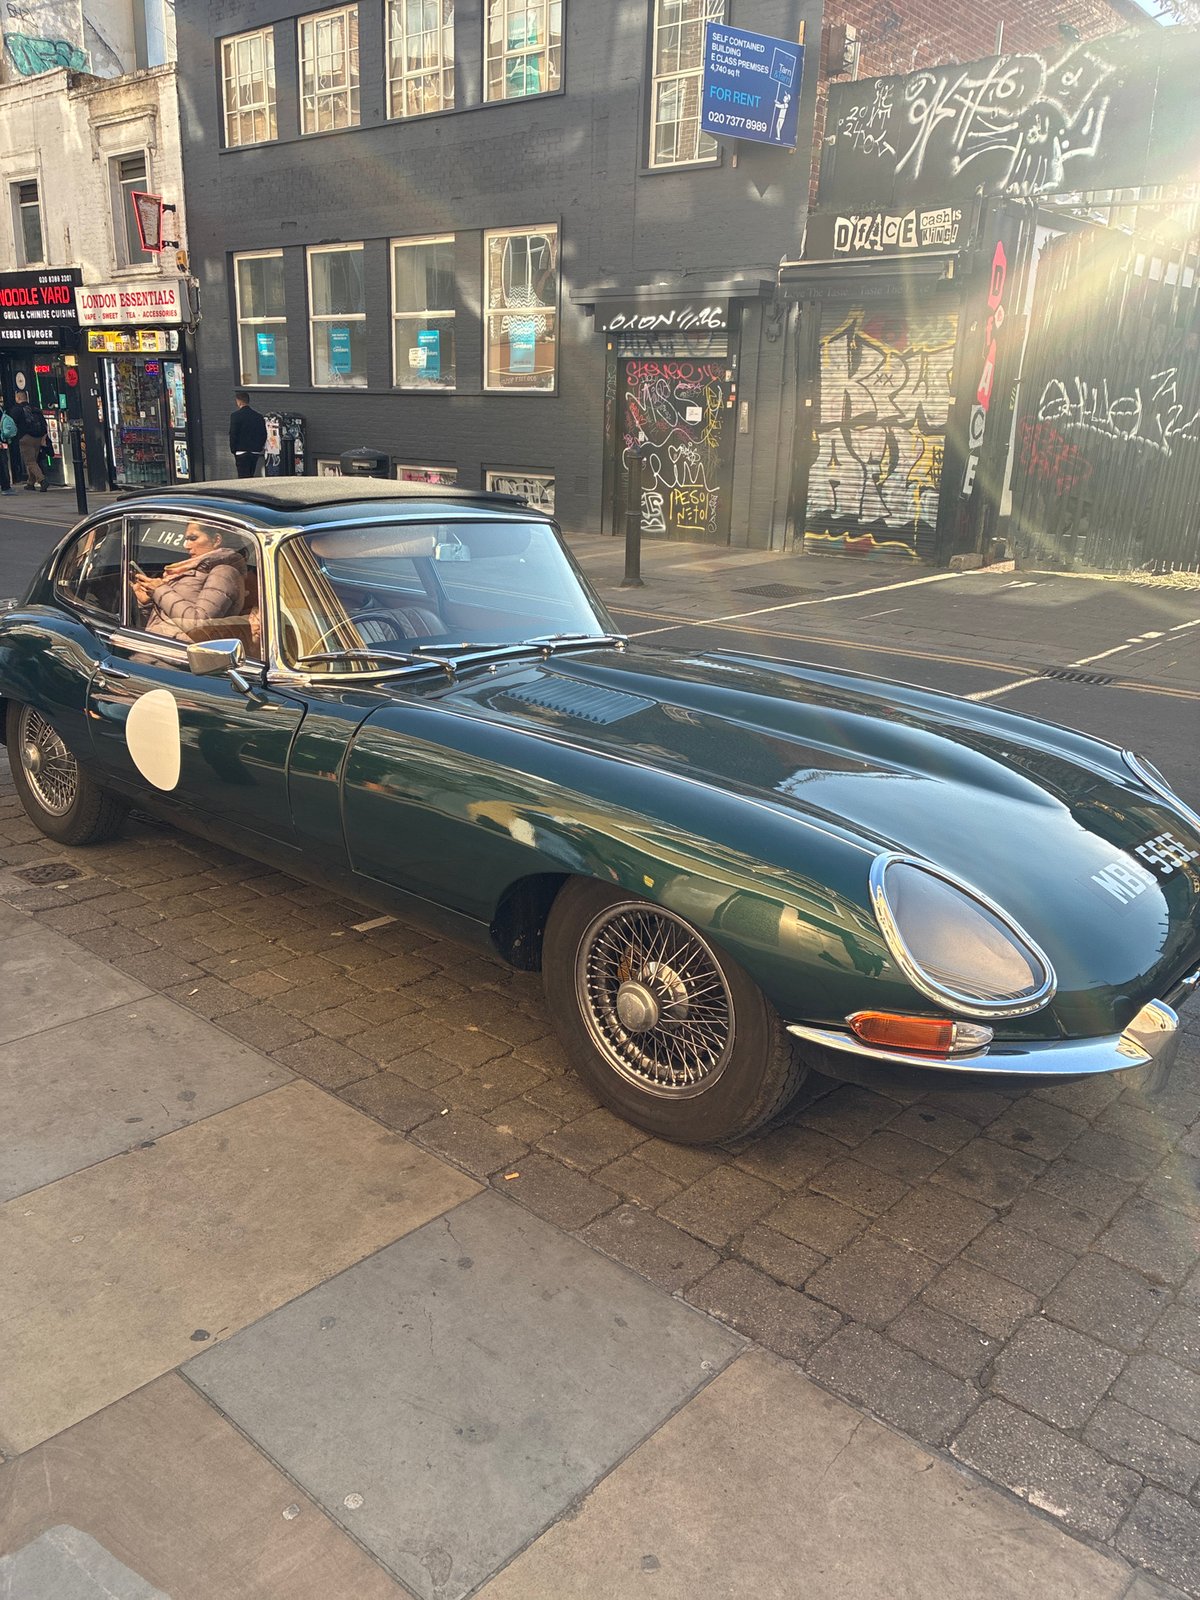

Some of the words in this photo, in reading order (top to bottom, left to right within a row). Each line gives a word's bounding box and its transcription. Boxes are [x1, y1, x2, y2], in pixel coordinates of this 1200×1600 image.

[711, 43, 742, 57] BUILDING
[712, 32, 728, 43] SELF
[729, 37, 765, 53] CONTAINED
[710, 63, 727, 74] 4,740
[727, 68, 735, 78] sq
[735, 69, 741, 78] ft
[711, 53, 716, 61] E
[716, 54, 738, 66] CLASS
[738, 60, 770, 74] PREMISES
[779, 63, 792, 76] Tarn
[710, 85, 732, 103] FOR
[733, 90, 761, 108] RENT
[708, 111, 725, 124] 020
[725, 114, 746, 128] 7377
[745, 119, 767, 133] 8989
[921, 209, 951, 228] cash
[0, 287, 39, 306] NOODLE
[40, 286, 70, 304] YARD
[81, 293, 117, 309] LONDON
[119, 289, 175, 307] ESSENTIALS
[807, 288, 824, 297] The
[3, 311, 19, 320] GRILL
[20, 311, 25, 319] &
[26, 310, 50, 319] CHINISE
[51, 309, 76, 318] CUISINE
[102, 312, 118, 320] SWEET
[143, 309, 178, 318] ACCESSORIES
[1, 330, 21, 339] KEBEB
[26, 329, 53, 339] BURGER
[674, 488, 706, 505] PESO
[1134, 831, 1200, 874] 555E
